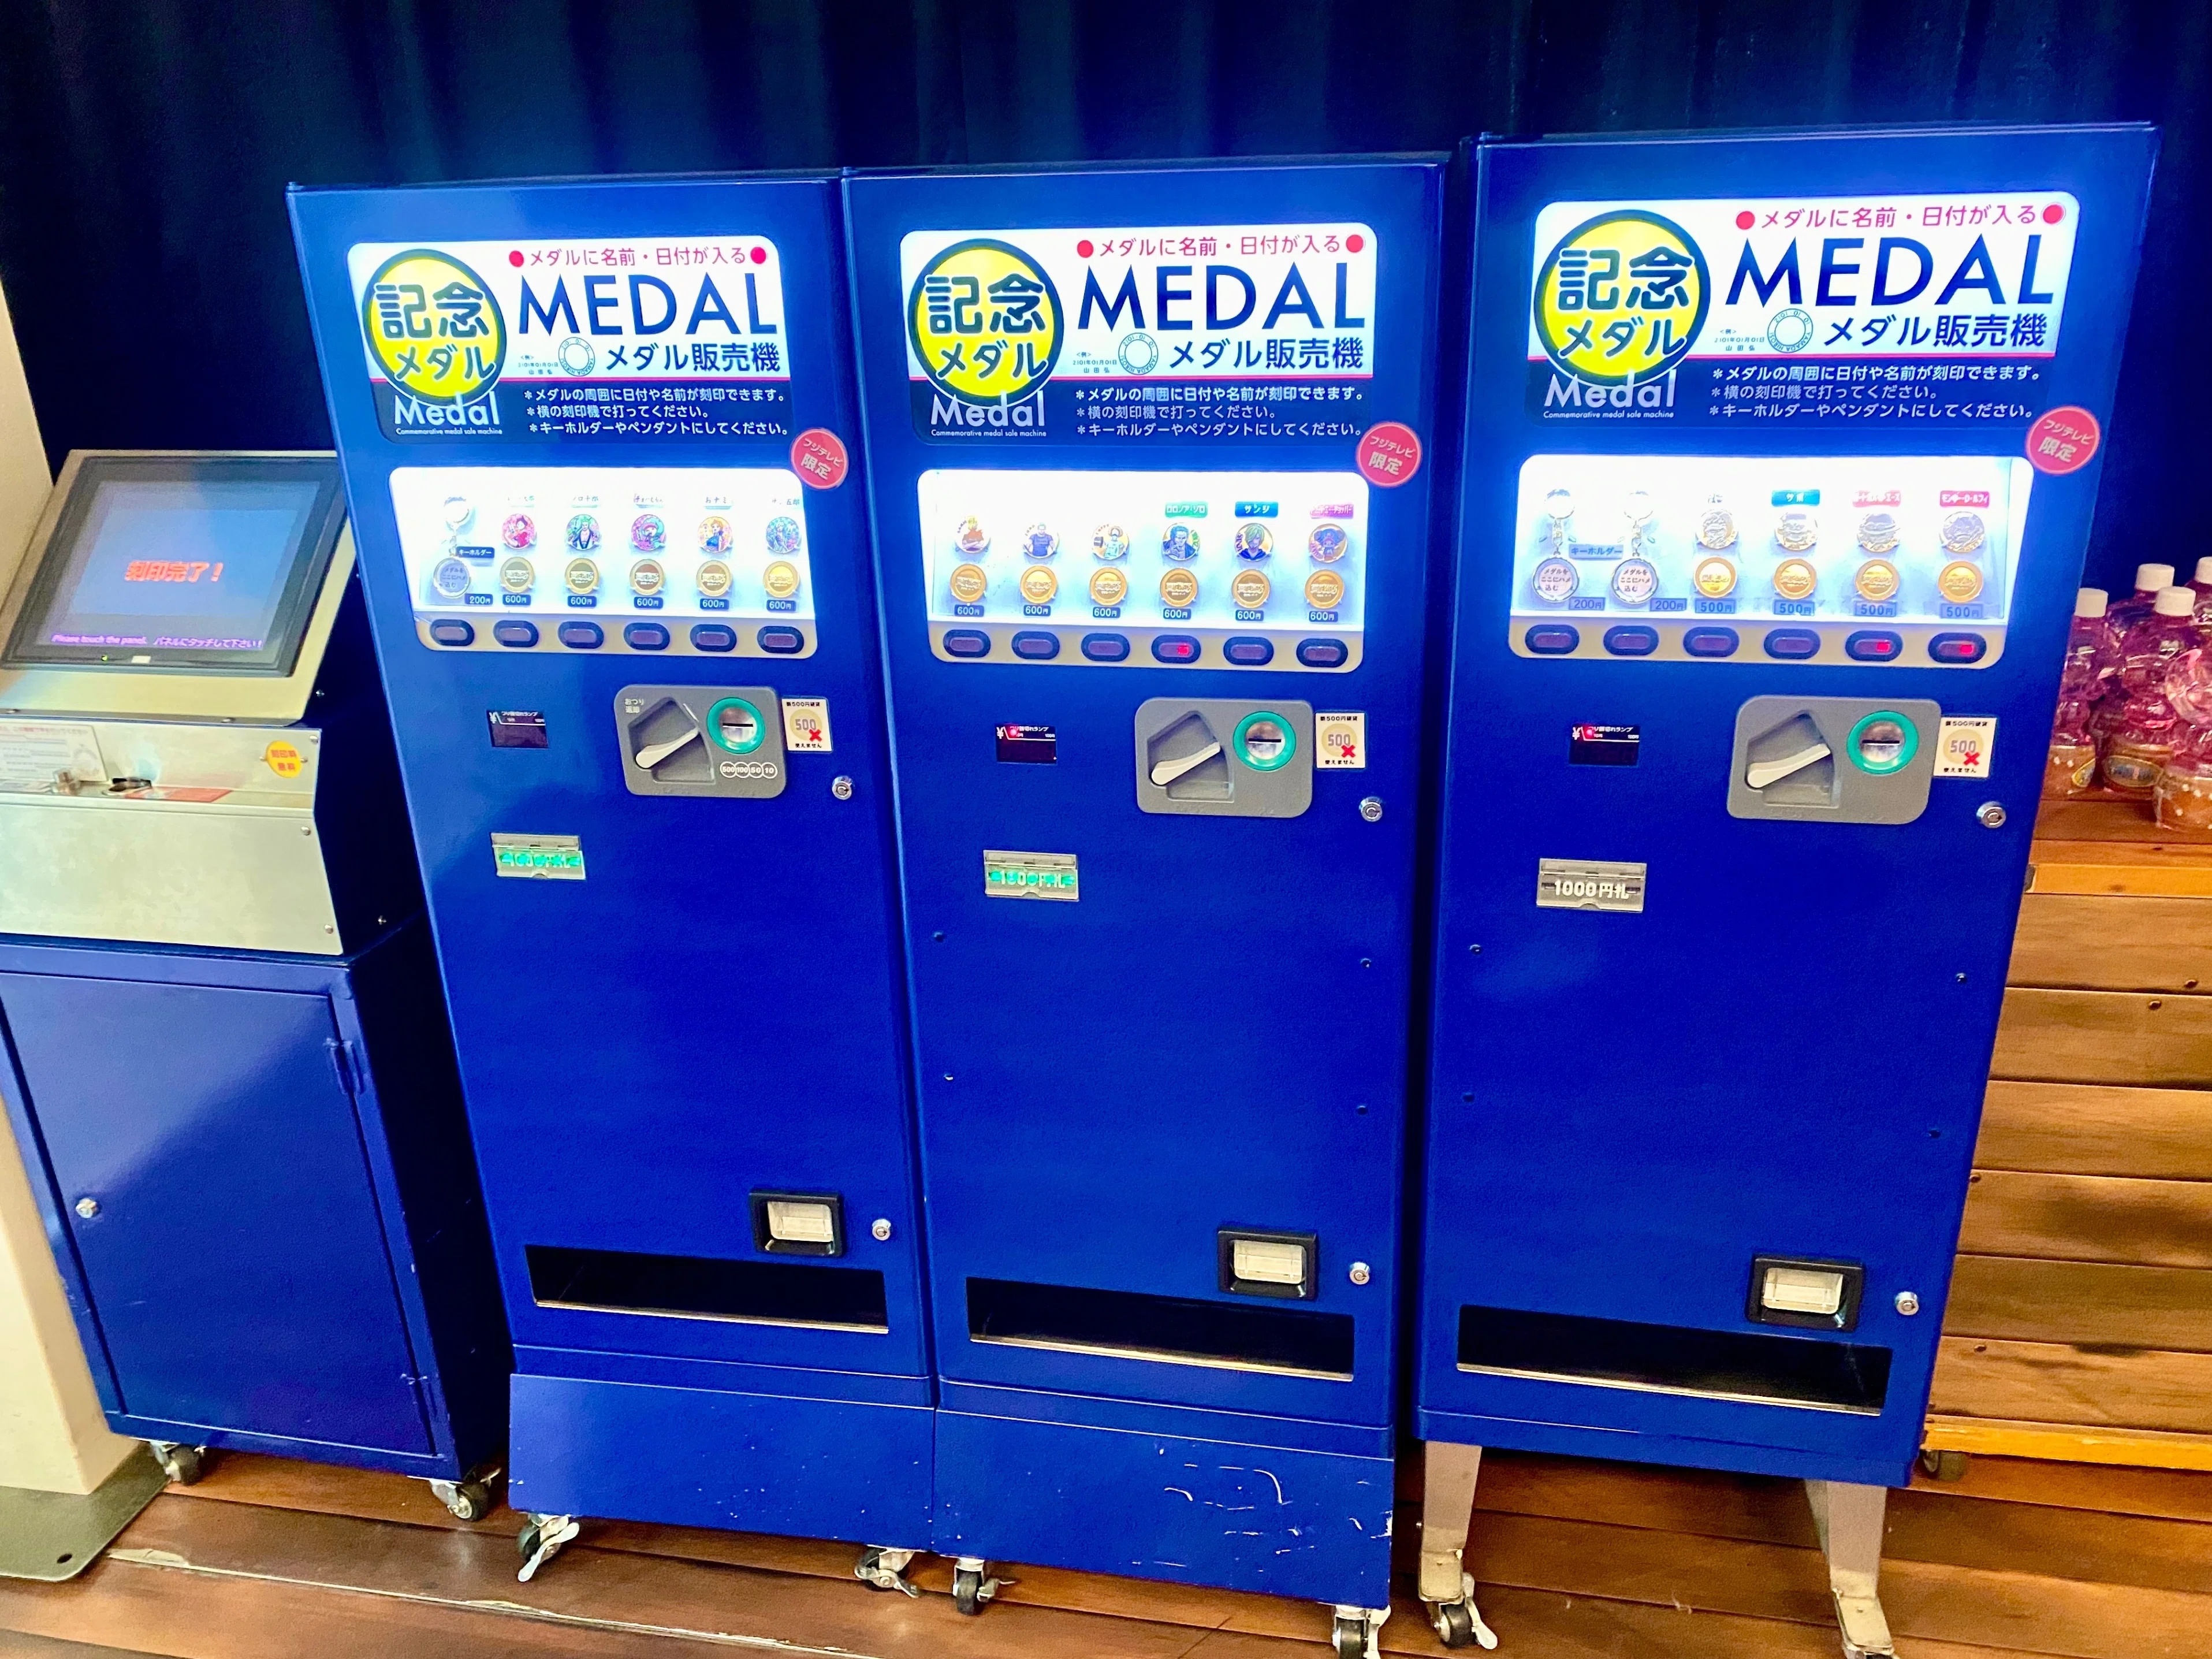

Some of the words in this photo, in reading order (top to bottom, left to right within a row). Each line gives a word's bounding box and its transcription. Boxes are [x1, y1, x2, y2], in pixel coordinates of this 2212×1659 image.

[1761, 204, 2036, 230] メダルに名前・日付が入る
[1099, 234, 1340, 257] メダルに名前・日付が入る
[530, 246, 747, 266] メダルに名前・日付が入る
[1559, 245, 1695, 311] 記念
[1726, 233, 2055, 311] MEDAL
[519, 271, 777, 338] MEDAL
[927, 273, 1045, 334] 記念
[1077, 262, 1365, 332] MEDAL
[375, 282, 489, 339] 記念
[1559, 316, 1687, 359] メダル
[1824, 314, 2047, 347] メダル販売機
[395, 343, 494, 381] メダル
[606, 343, 780, 373] メダル販売機
[937, 341, 1050, 379] メダル
[1168, 338, 1364, 369] メダル販売機
[1544, 369, 1675, 409] Medal
[394, 391, 500, 425] Medal
[931, 391, 1044, 427] Medal
[1543, 410, 1599, 419] Commemorative
[1602, 410, 1624, 419] medal
[1627, 410, 1641, 419] sale
[1643, 410, 1674, 419] machine
[1020, 429, 1047, 437] machine
[2043, 419, 2094, 445] フジテレビ
[803, 438, 843, 467] フジテレビ
[1369, 436, 1416, 458] フジテレビ
[2038, 436, 2077, 462] 限定
[800, 453, 832, 480] 限定
[1368, 451, 1403, 475] 限定
[1571, 546, 1622, 555] キーホルダー
[469, 596, 491, 604] 200円
[505, 595, 527, 604] 600円
[571, 597, 592, 605] 600円
[636, 598, 658, 607] 600円
[702, 599, 725, 608] 600円
[769, 601, 791, 610] 600円
[1574, 600, 1602, 609] 200円
[1655, 601, 1684, 611] 200円
[1700, 602, 1732, 612] 500円
[1779, 604, 1812, 614] 500円
[957, 607, 980, 615] 600円
[1025, 606, 1048, 615] 600円
[1094, 608, 1117, 617] 600円
[1164, 609, 1188, 618] 600円
[1238, 611, 1261, 620] 600円
[1310, 612, 1334, 621] 600円
[1860, 604, 1893, 615] 500円
[1946, 607, 1980, 618] 500円
[795, 719, 816, 731] 500
[1328, 734, 1350, 746] 500
[1950, 740, 1976, 753] 500
[1554, 880, 1629, 899] 1000円札
